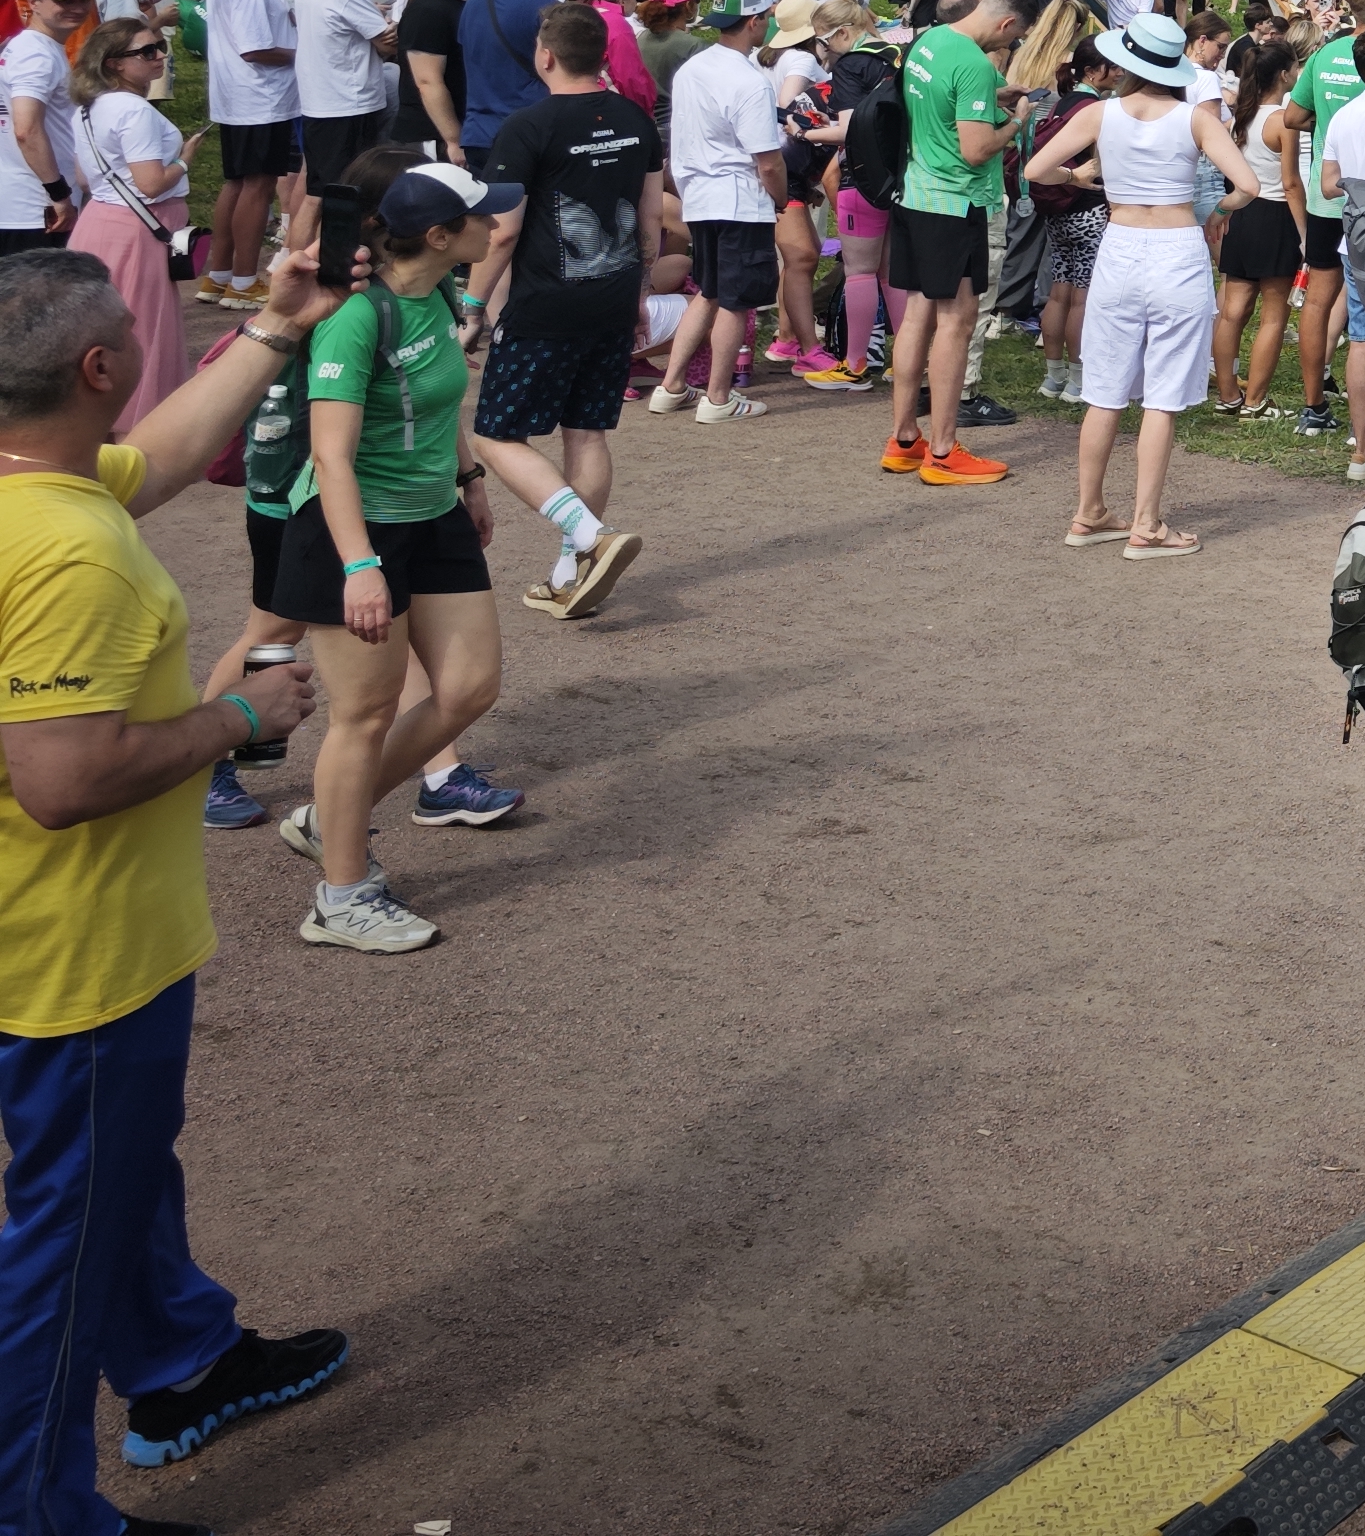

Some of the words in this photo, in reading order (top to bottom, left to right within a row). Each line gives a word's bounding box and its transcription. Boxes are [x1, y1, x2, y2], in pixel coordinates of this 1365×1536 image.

[1320, 71, 1361, 83] RUNNER
[569, 136, 640, 155] ORGANIZER
[398, 335, 436, 361] RUNIT
[318, 363, 345, 379] GRi
[10, 676, 39, 699] Rick
